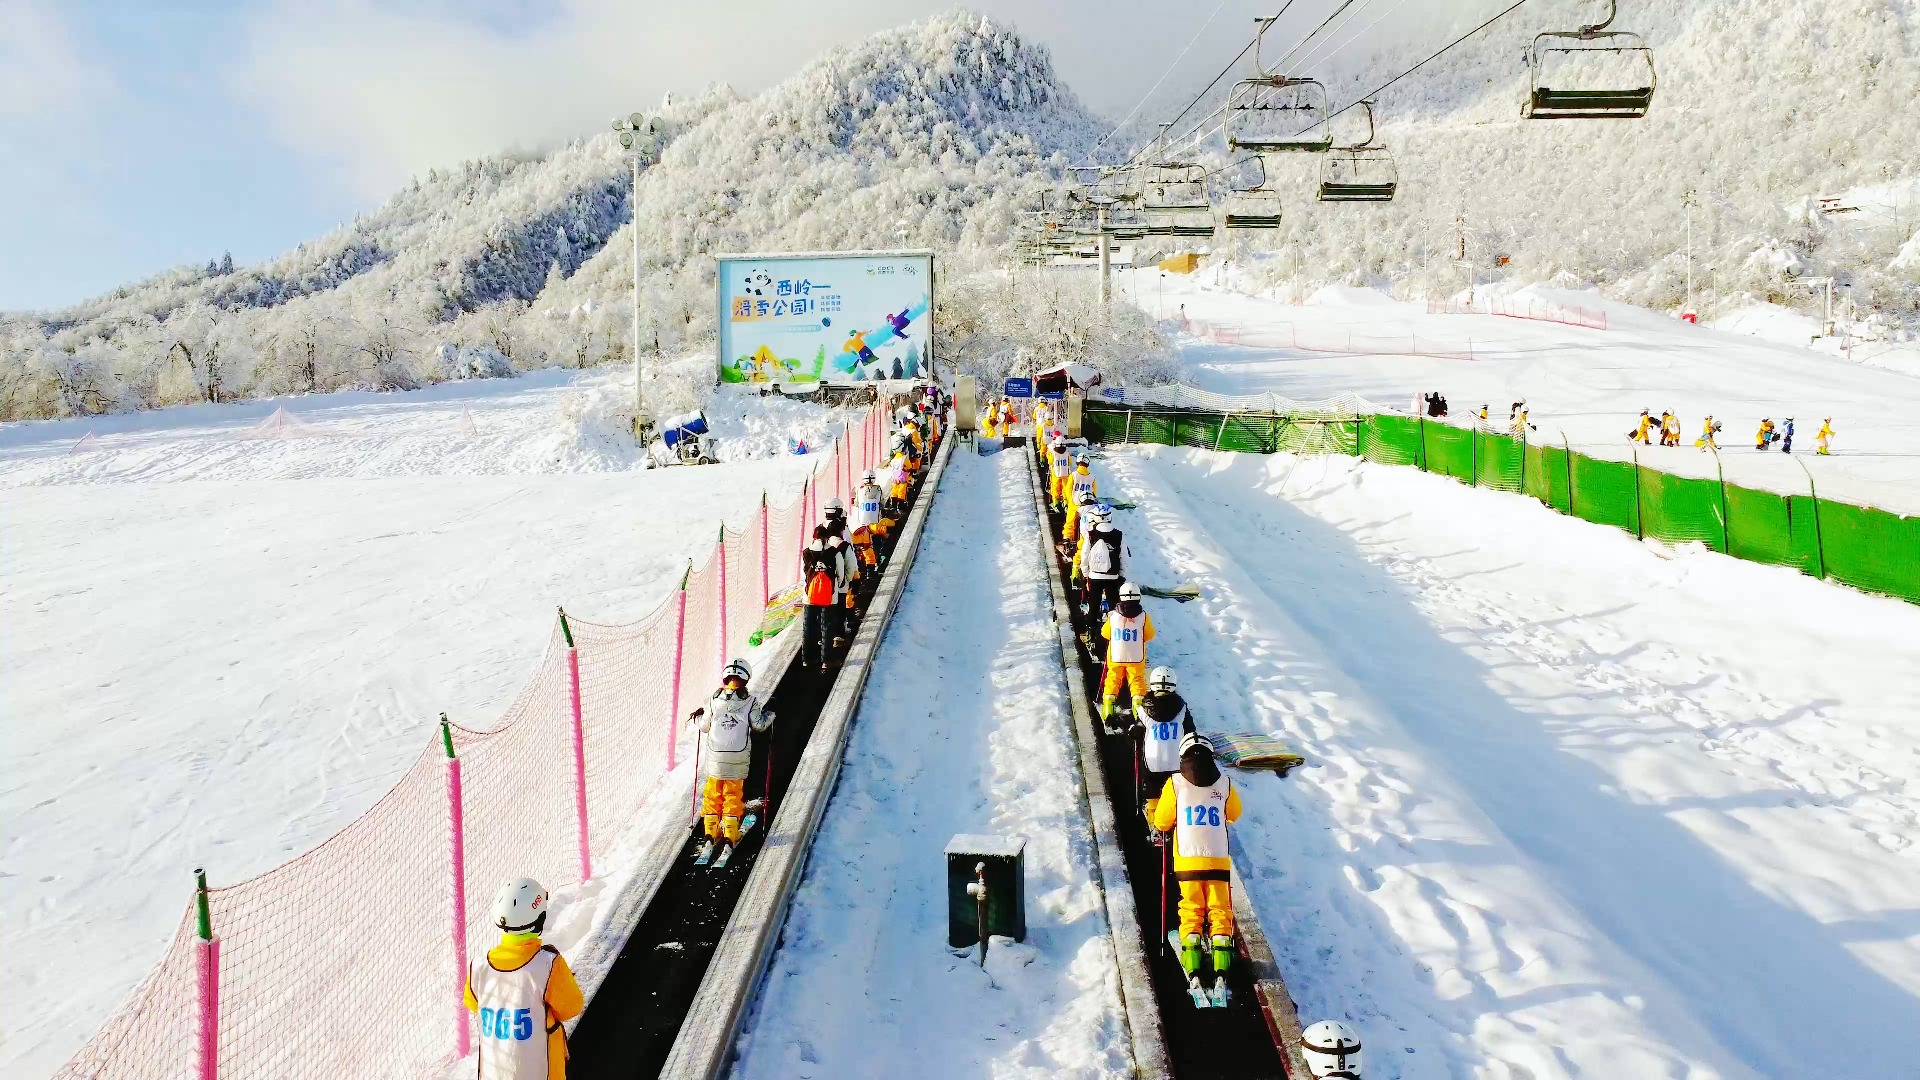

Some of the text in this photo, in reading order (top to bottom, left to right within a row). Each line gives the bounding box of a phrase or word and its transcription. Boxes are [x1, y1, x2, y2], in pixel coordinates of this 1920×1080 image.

[1115, 628, 1137, 641] 061
[1185, 805, 1220, 826] 126
[481, 1007, 533, 1040] 065
